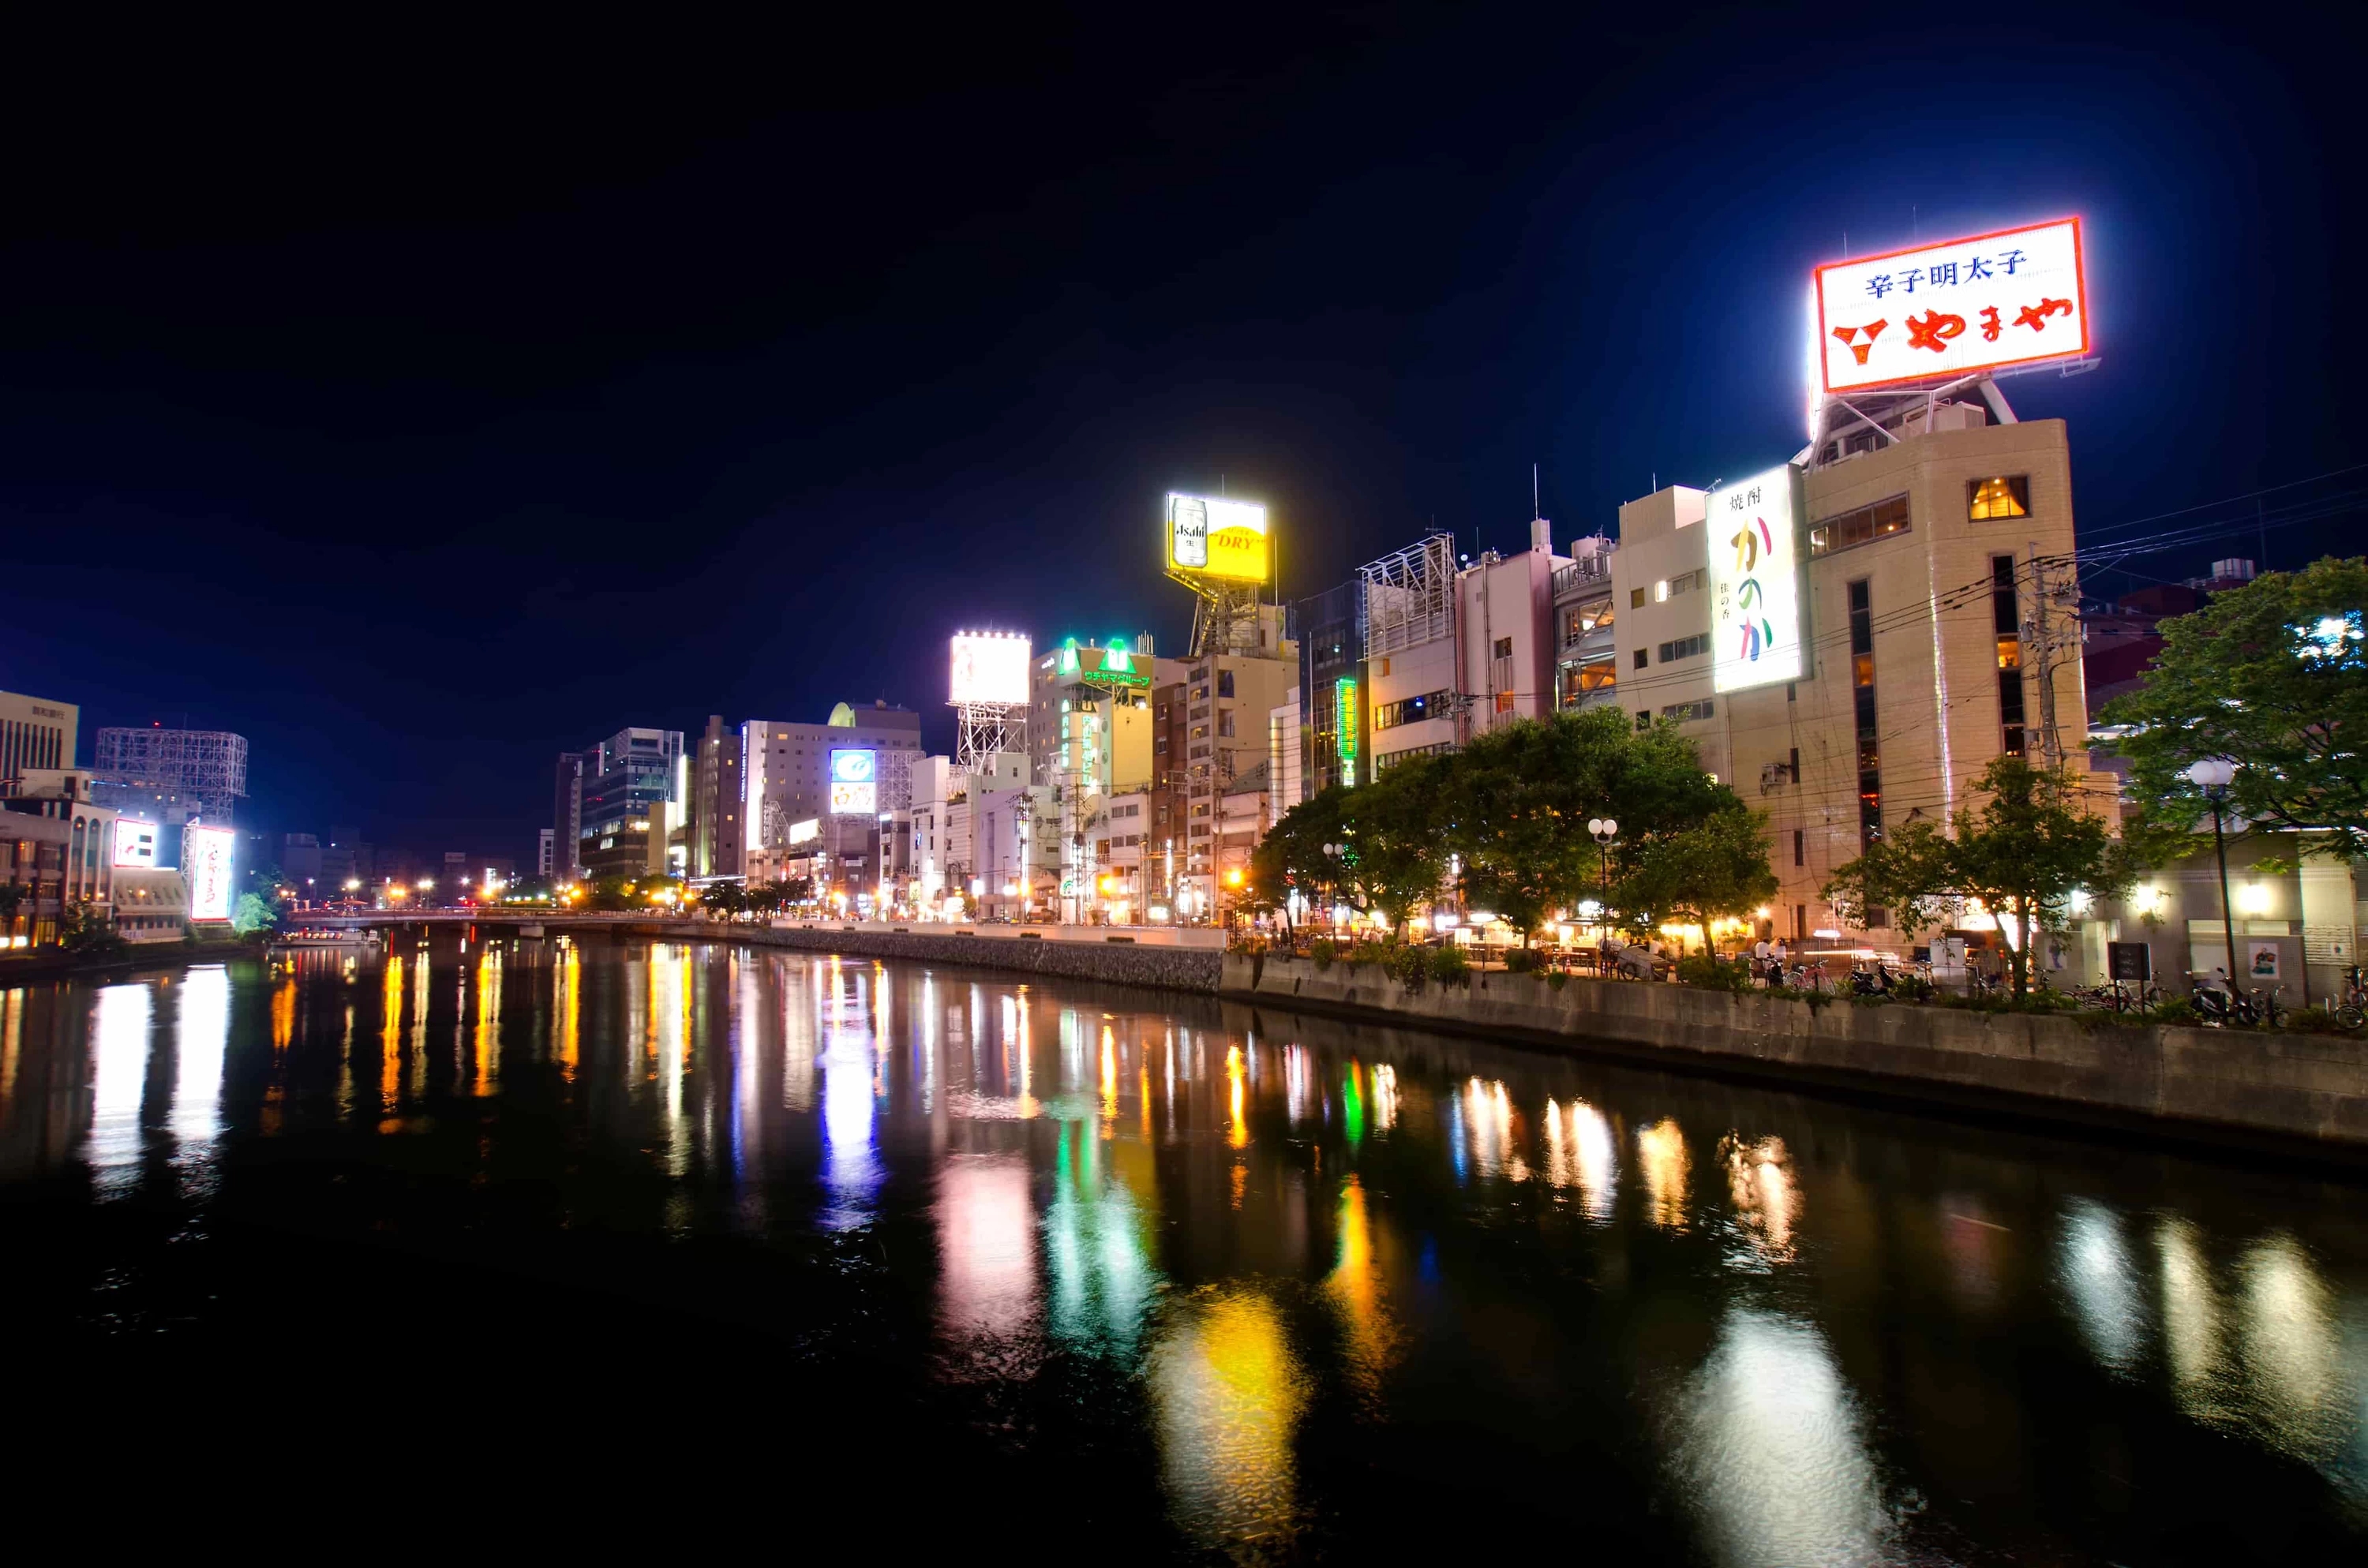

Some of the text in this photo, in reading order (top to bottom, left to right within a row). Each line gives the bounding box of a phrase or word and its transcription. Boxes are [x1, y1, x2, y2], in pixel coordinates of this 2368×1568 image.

[1865, 249, 2027, 299] 辛子明太子
[1905, 298, 2074, 354] やまや
[1729, 486, 1761, 511] 焼酎
[1176, 524, 1205, 538] Asahi
[1730, 516, 1773, 662] かのか
[1085, 671, 1150, 687] ウチヤマグループ
